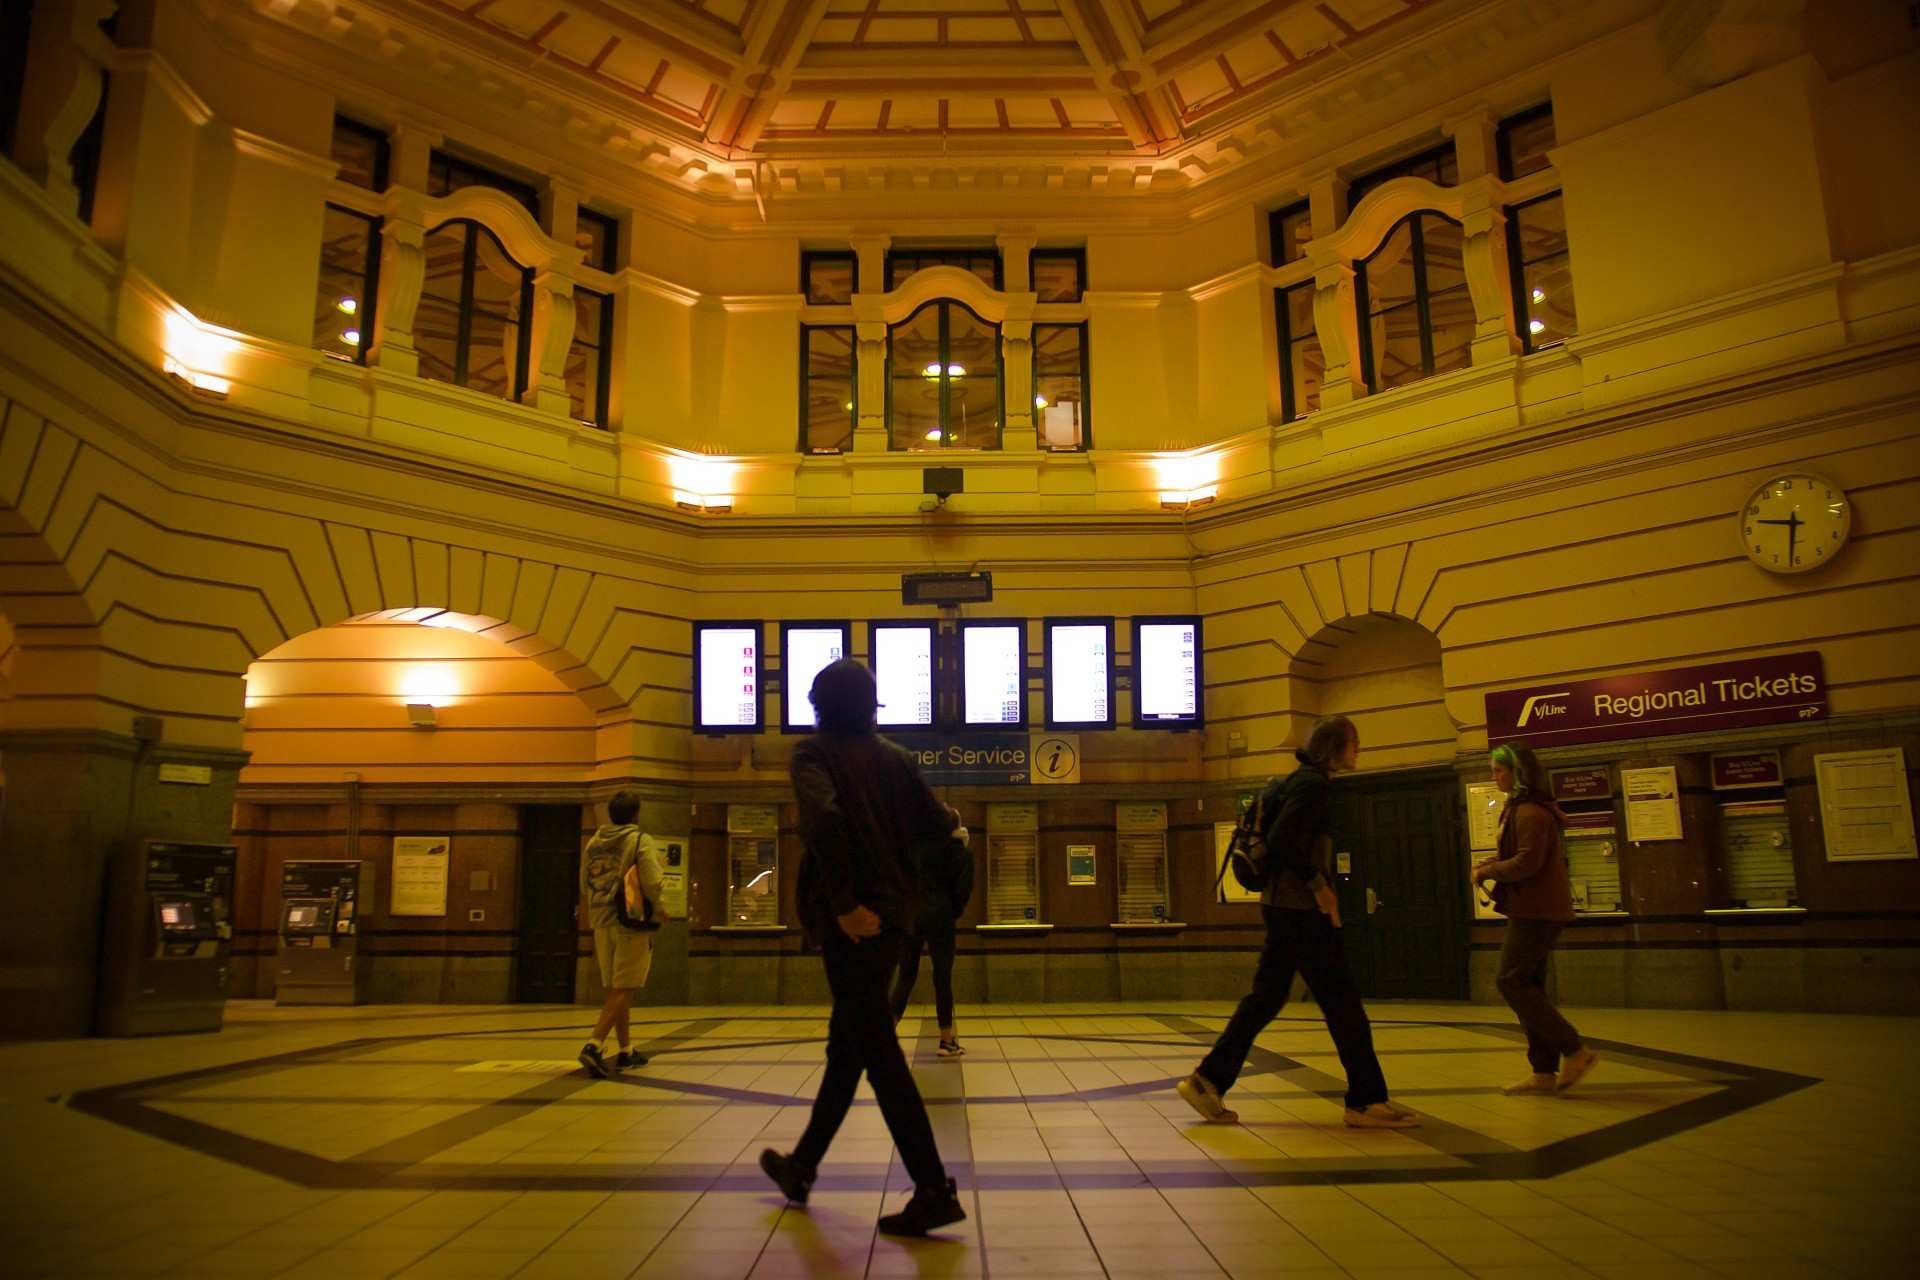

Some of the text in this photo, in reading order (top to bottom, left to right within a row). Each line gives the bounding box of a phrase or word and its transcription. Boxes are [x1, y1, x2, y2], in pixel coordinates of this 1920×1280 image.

[1594, 672, 1817, 718] Regional Tickets
[948, 745, 1025, 765] Service
